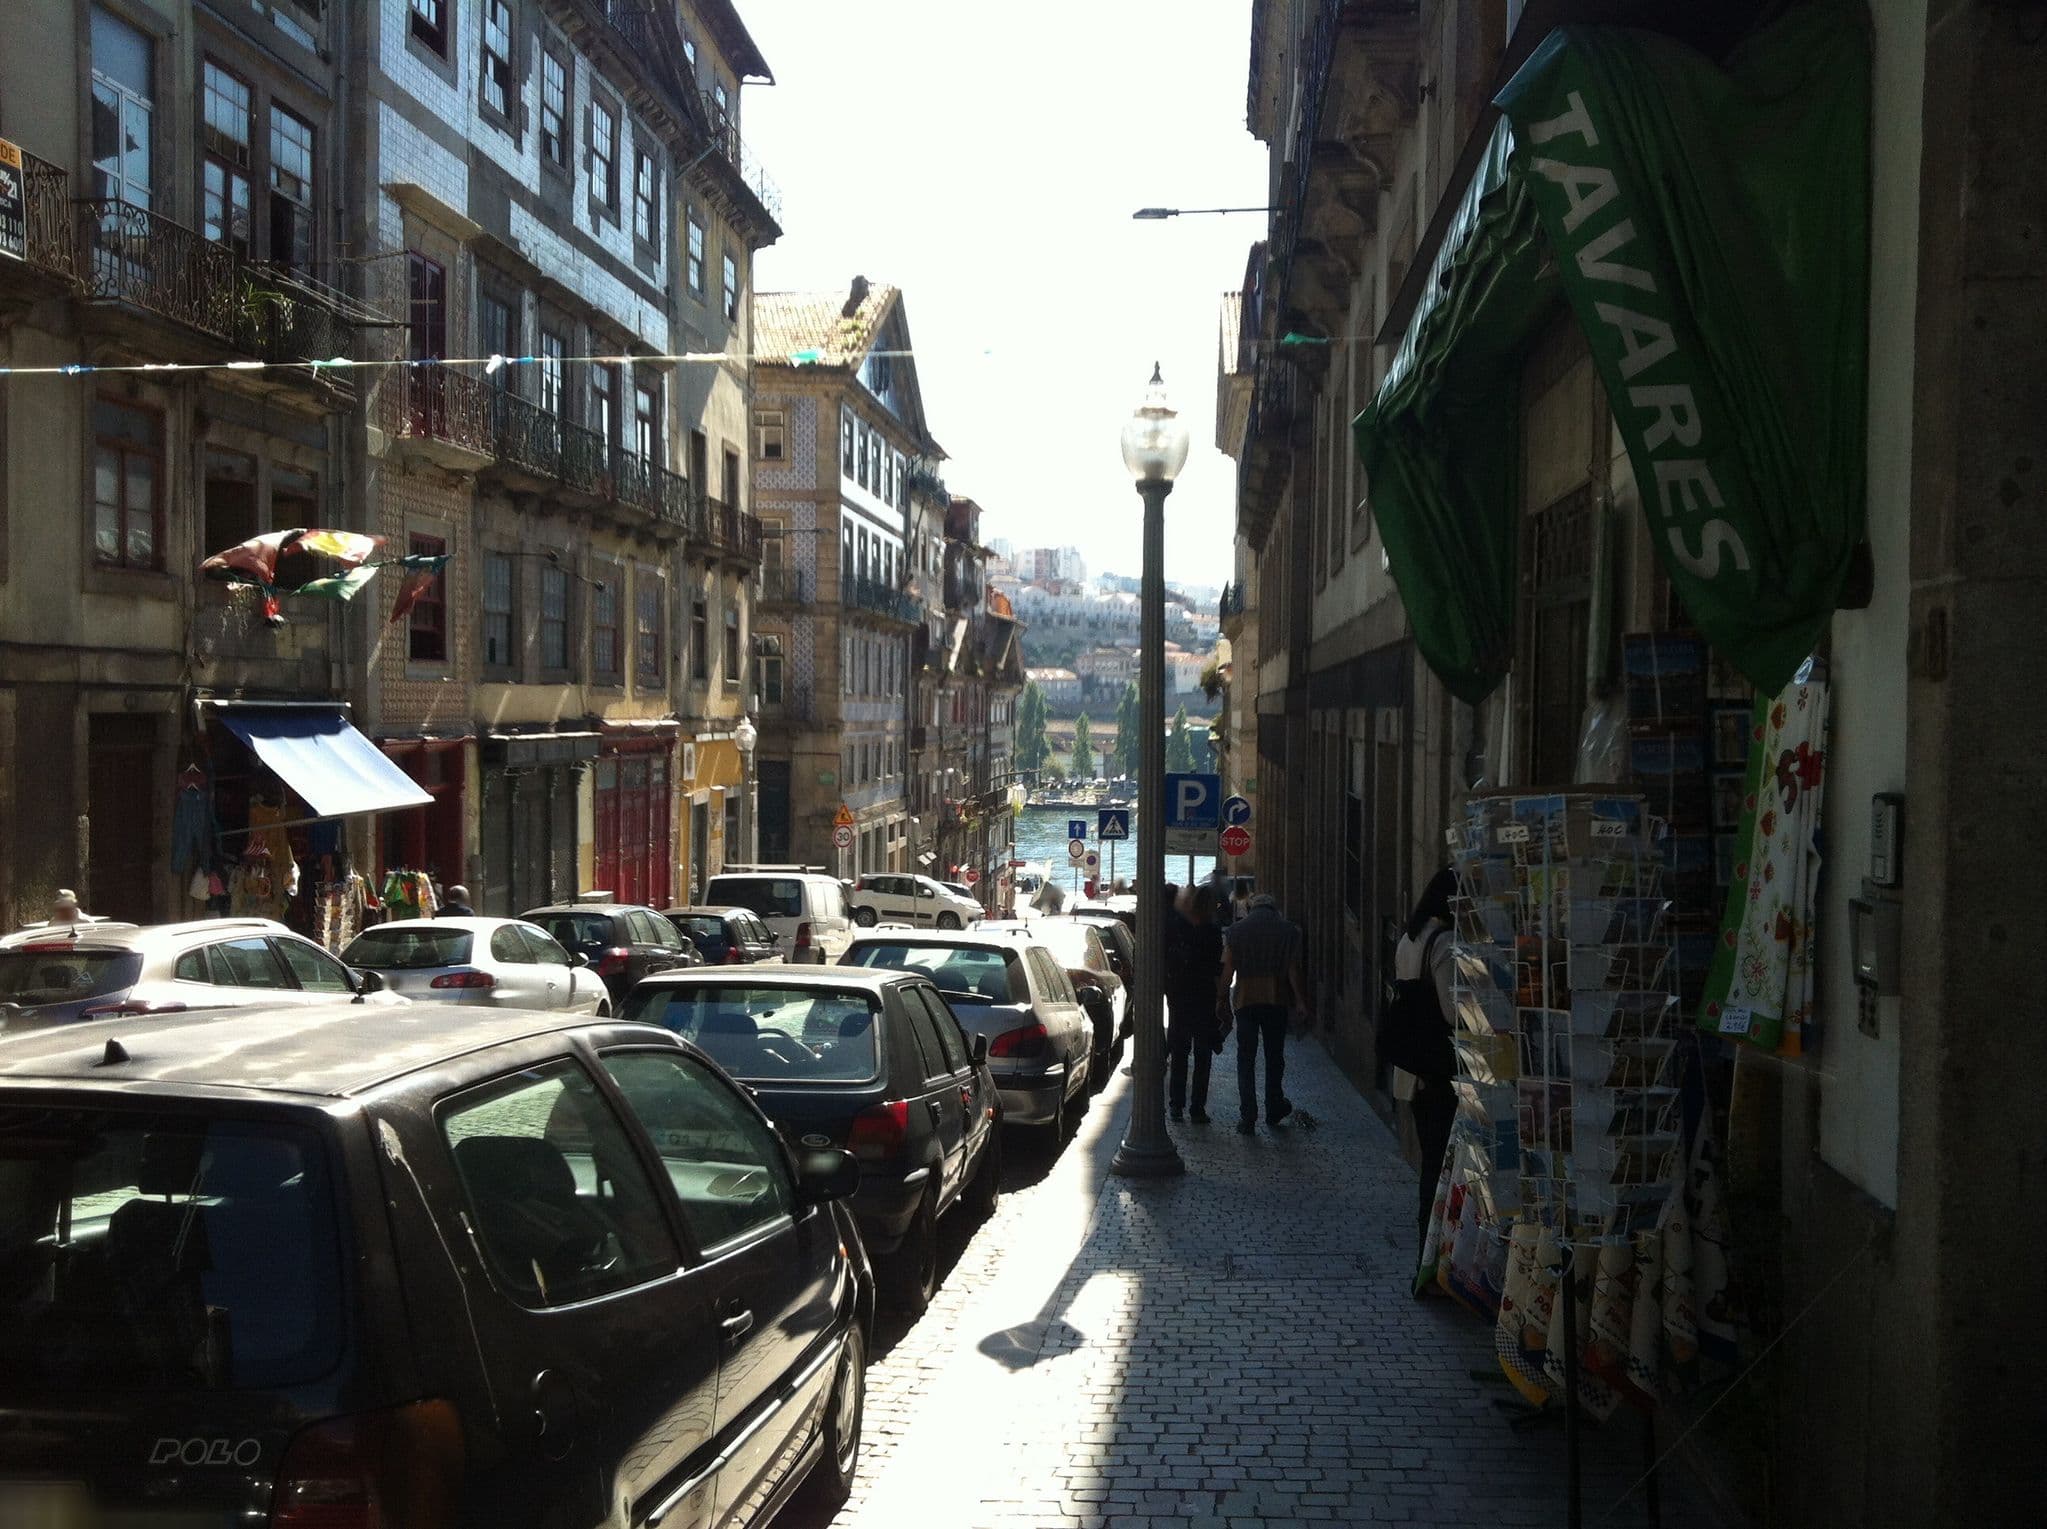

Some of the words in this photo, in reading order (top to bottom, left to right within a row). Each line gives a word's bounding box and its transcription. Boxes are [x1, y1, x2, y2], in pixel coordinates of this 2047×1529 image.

[1528, 90, 1750, 580] TAVARES
[1176, 780, 1207, 821] P
[836, 832, 850, 842] 30
[1221, 837, 1250, 847] STOP
[148, 1437, 262, 1466] POLO
